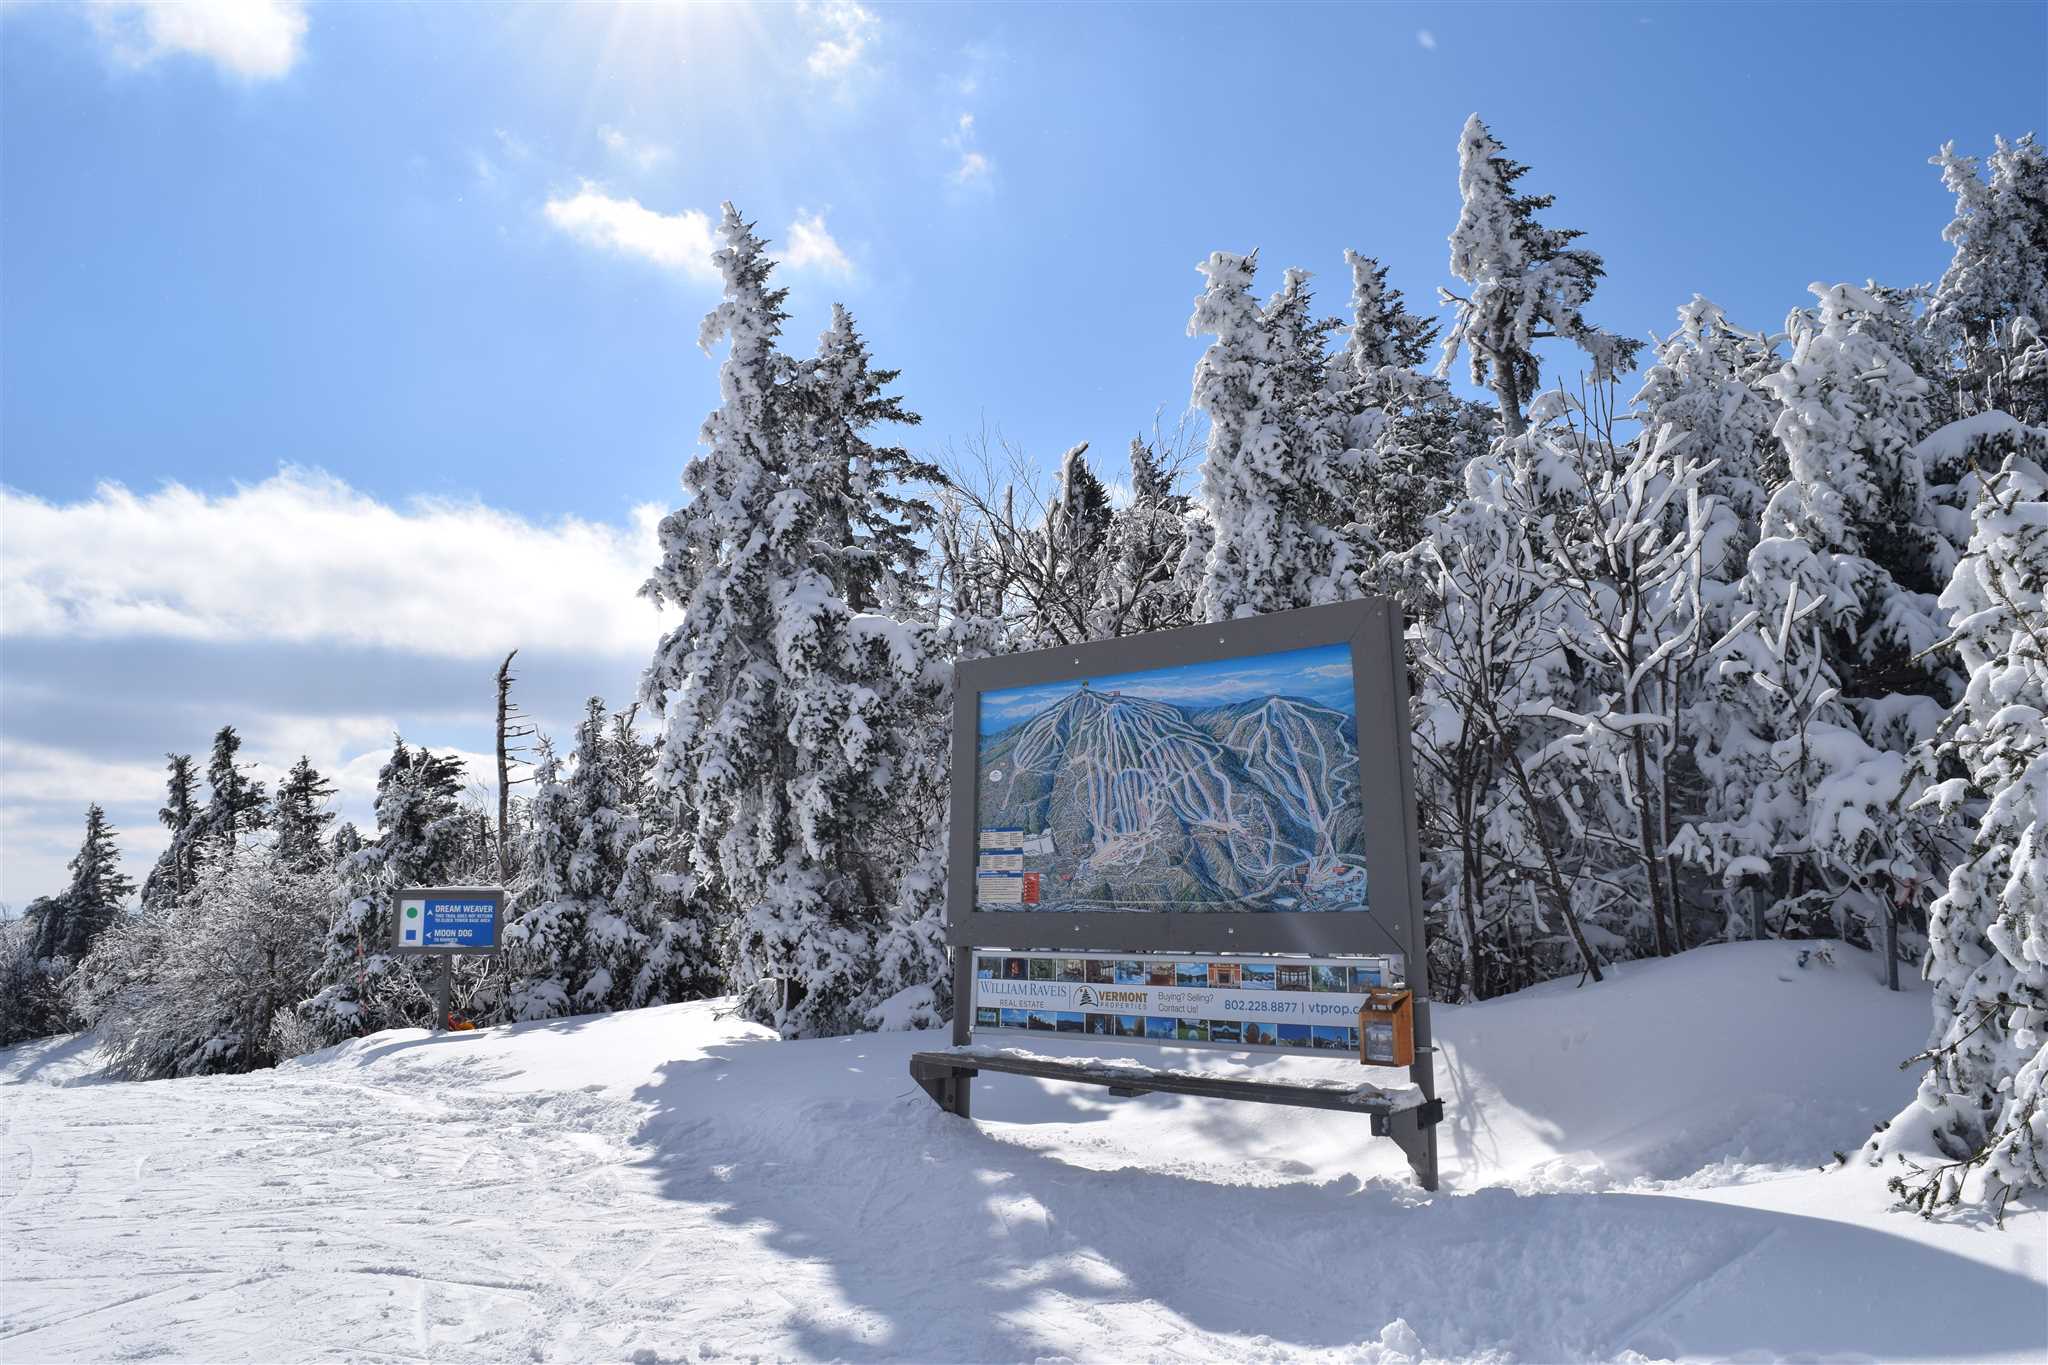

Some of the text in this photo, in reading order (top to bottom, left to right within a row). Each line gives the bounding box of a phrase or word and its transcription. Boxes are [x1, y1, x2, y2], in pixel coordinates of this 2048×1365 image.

[435, 905, 493, 913] DREAM WEAVER
[434, 929, 473, 937] MOON DOG
[980, 981, 1067, 997] WILLIAM RAVEIS
[1098, 991, 1148, 1003] VERMONT
[1158, 992, 1214, 1004] Buying? Selling?
[1000, 999, 1045, 1009] REAL ESTATE
[1100, 1002, 1147, 1010] PROPERTIES
[1158, 1003, 1199, 1014] Contact Us!
[1224, 999, 1297, 1013] 802.228.8877
[1308, 1002, 1361, 1015] vtprop.c
